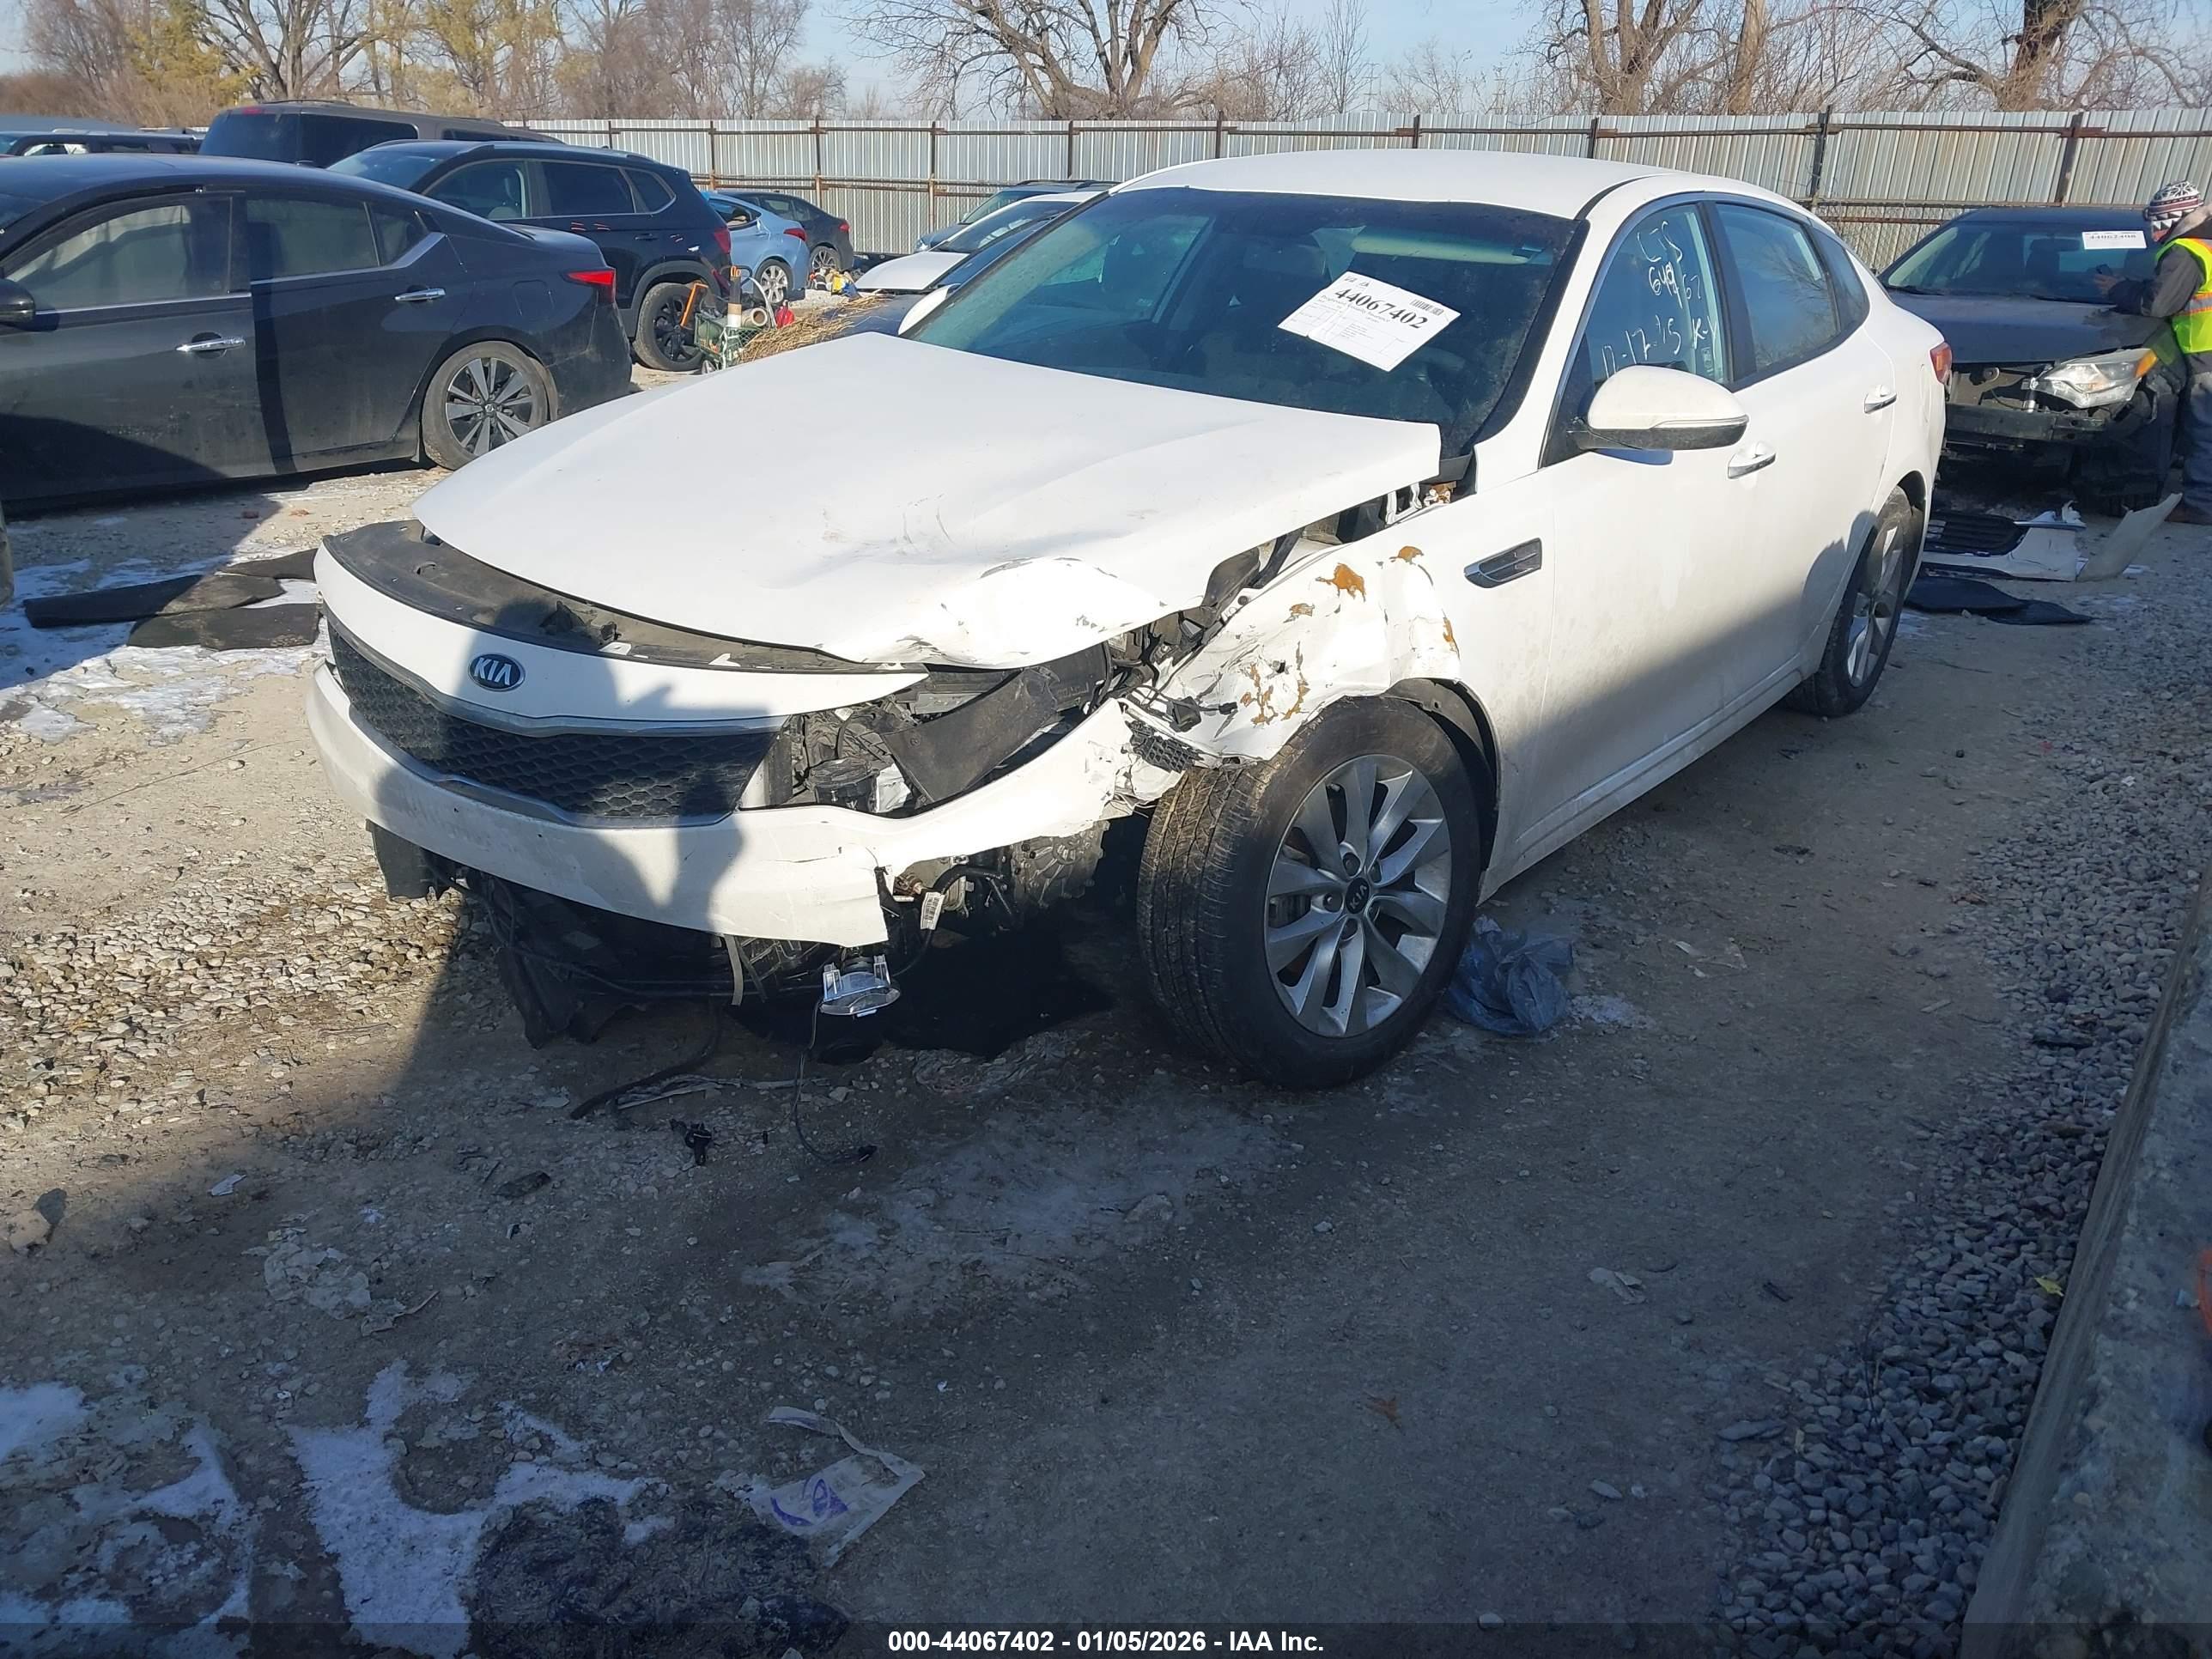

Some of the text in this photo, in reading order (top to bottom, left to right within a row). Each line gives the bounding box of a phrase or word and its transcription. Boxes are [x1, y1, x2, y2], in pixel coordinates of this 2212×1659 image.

[1334, 289, 1429, 329] 44067402
[474, 657, 513, 686] KIA
[1349, 884, 1368, 910] KIA
